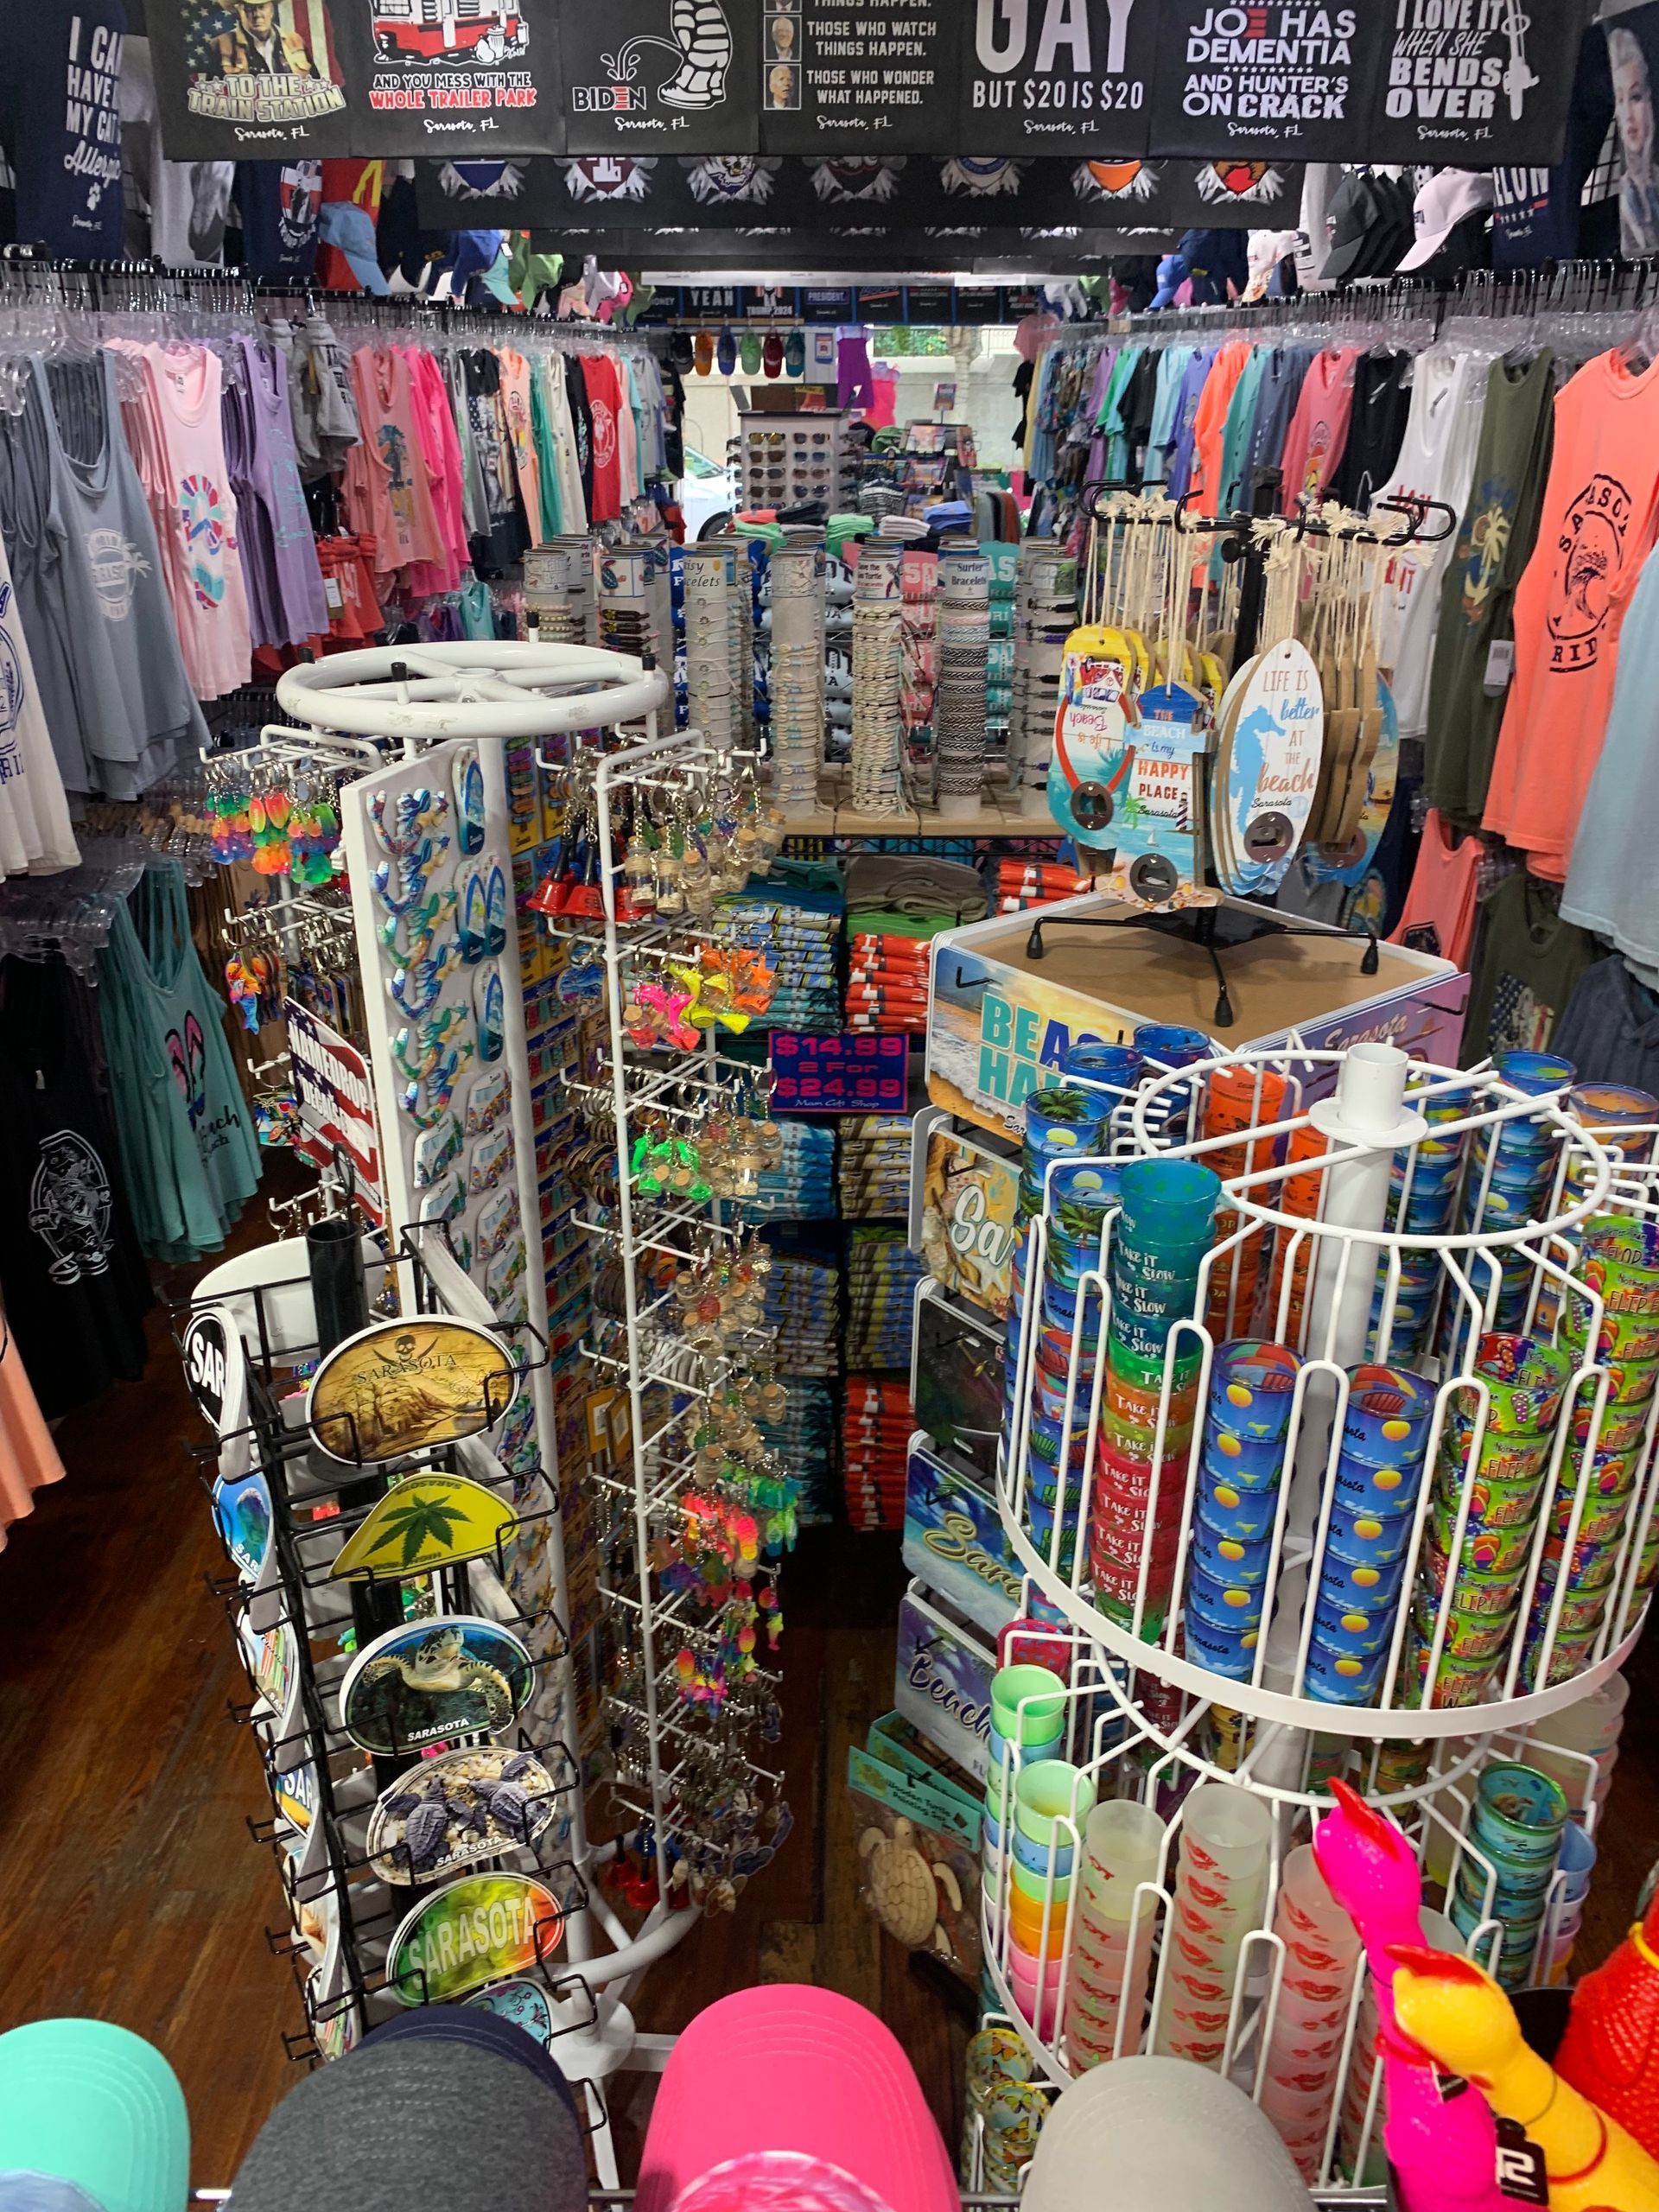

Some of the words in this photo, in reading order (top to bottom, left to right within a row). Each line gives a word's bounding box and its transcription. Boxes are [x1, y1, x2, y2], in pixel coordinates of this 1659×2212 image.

[1189, 7, 1268, 38] JOE
[1279, 9, 1357, 39] HAS
[1395, 0, 1408, 29] I
[1412, 0, 1471, 29] LOVE
[1478, 0, 1504, 29] IT
[68, 16, 81, 60] I
[807, 22, 850, 36] THOSE
[855, 22, 886, 36] WHO
[891, 22, 938, 36] WATCH
[976, 0, 1135, 73] GAY
[815, 41, 863, 56] THINGS
[868, 41, 926, 56] HAPPEN.
[1186, 37, 1351, 65] DEMENTIA
[1392, 31, 1450, 57] WHEN
[1448, 31, 1495, 56] SHE
[373, 73, 401, 90] AND
[403, 73, 432, 89] YOU
[435, 73, 472, 88] MESS
[474, 73, 505, 88] WITH
[507, 72, 531, 87] THE
[806, 70, 846, 85] THOSE
[850, 70, 879, 85] WHO
[883, 70, 935, 85] WONDER
[1389, 57, 1503, 87] BENDS
[67, 64, 113, 108] HAVE
[224, 74, 256, 98] TO
[257, 73, 302, 98] THE
[1184, 74, 1233, 92] AND
[1238, 75, 1349, 93] HUNTER'S
[188, 87, 255, 122] TRAIN
[257, 85, 346, 122] STATION
[369, 90, 426, 110] WHOLE
[427, 89, 492, 109] TRAILER
[495, 87, 537, 107] PARK
[572, 86, 646, 111] BIDEN
[817, 90, 851, 104] WHAT
[855, 90, 923, 104] HAPPENED.
[973, 79, 1016, 108] BUT
[1023, 78, 1066, 110] $20
[1072, 79, 1093, 109] IS
[1100, 79, 1143, 111] $20
[1385, 87, 1497, 119] OVER
[1182, 92, 1233, 117] ON
[1236, 92, 1347, 120] CRACK
[66, 100, 94, 137] MY
[480, 118, 499, 131] FL
[671, 116, 690, 130] FL
[873, 115, 893, 130] FL
[1080, 119, 1099, 132] FL
[290, 125, 309, 139] FL
[1283, 124, 1304, 138] FL
[1473, 126, 1493, 140] FL
[691, 289, 734, 306] YEAH
[957, 563, 983, 573] Surfer
[952, 576, 988, 586] Bracelets
[1263, 671, 1289, 692] LIFE
[1296, 670, 1308, 691] IS
[1154, 709, 1173, 721] THE
[1280, 697, 1320, 721] better
[1143, 723, 1185, 740] BEACH
[1287, 730, 1304, 747] AT
[1285, 752, 1300, 765] THE
[1137, 760, 1189, 780] HAPPY
[1257, 758, 1314, 793] beach
[1139, 783, 1179, 800] PLACE
[1251, 797, 1292, 809] Sarasota
[775, 1034, 903, 1057] $14.99
[798, 1061, 819, 1072] 2
[826, 1062, 879, 1073] For
[777, 1077, 900, 1098] $24.99
[1134, 1298, 1166, 1315] SLOW
[1131, 1338, 1164, 1354] SLOW
[357, 1353, 457, 1384] SARASOTA
[407, 1718, 469, 1742] SARASOTA
[436, 1835, 504, 1866] SARASOTA
[409, 1897, 543, 1991] SARASOTA
